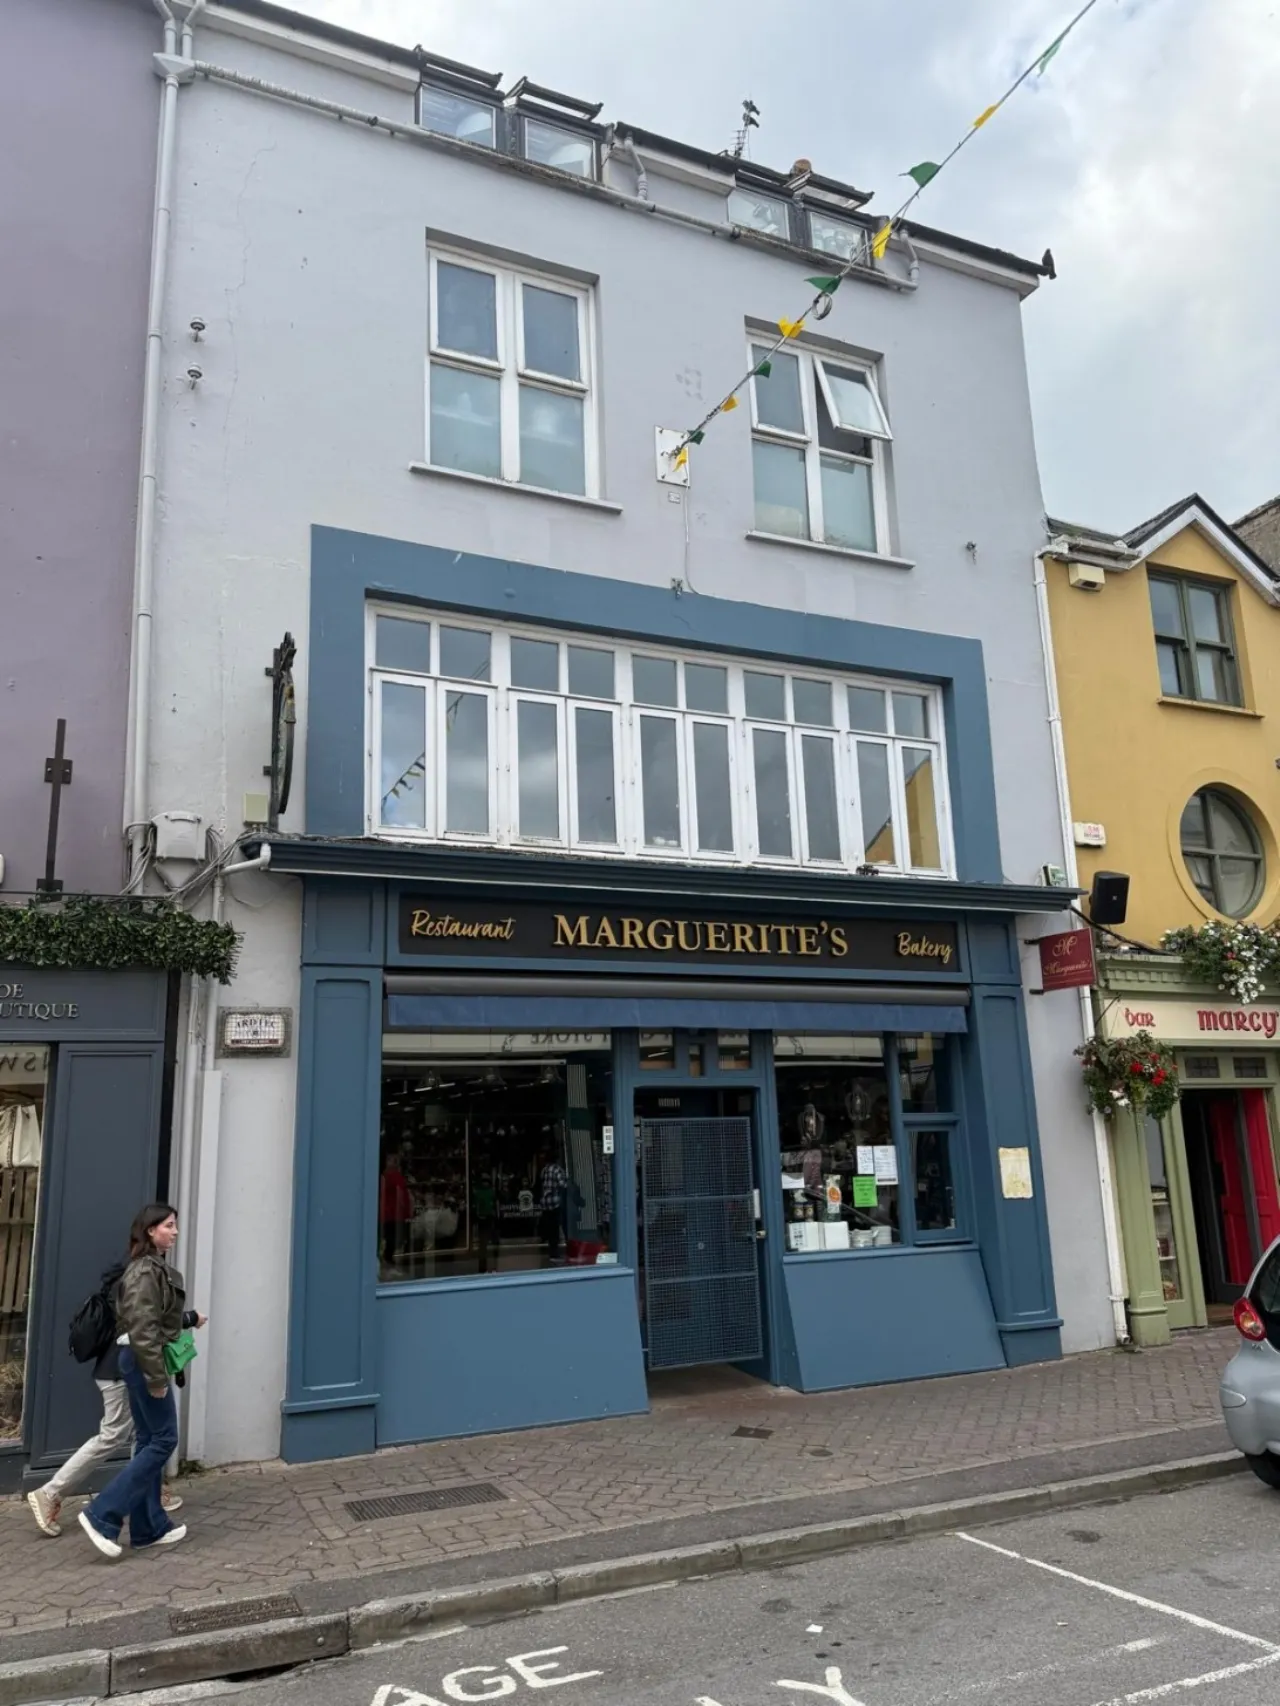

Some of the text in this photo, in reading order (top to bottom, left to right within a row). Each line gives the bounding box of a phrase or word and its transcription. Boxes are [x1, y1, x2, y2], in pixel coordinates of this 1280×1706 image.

[410, 909, 514, 941] Restaurant
[554, 914, 848, 957] MARGUERITE'S
[897, 932, 953, 964] Bakery
